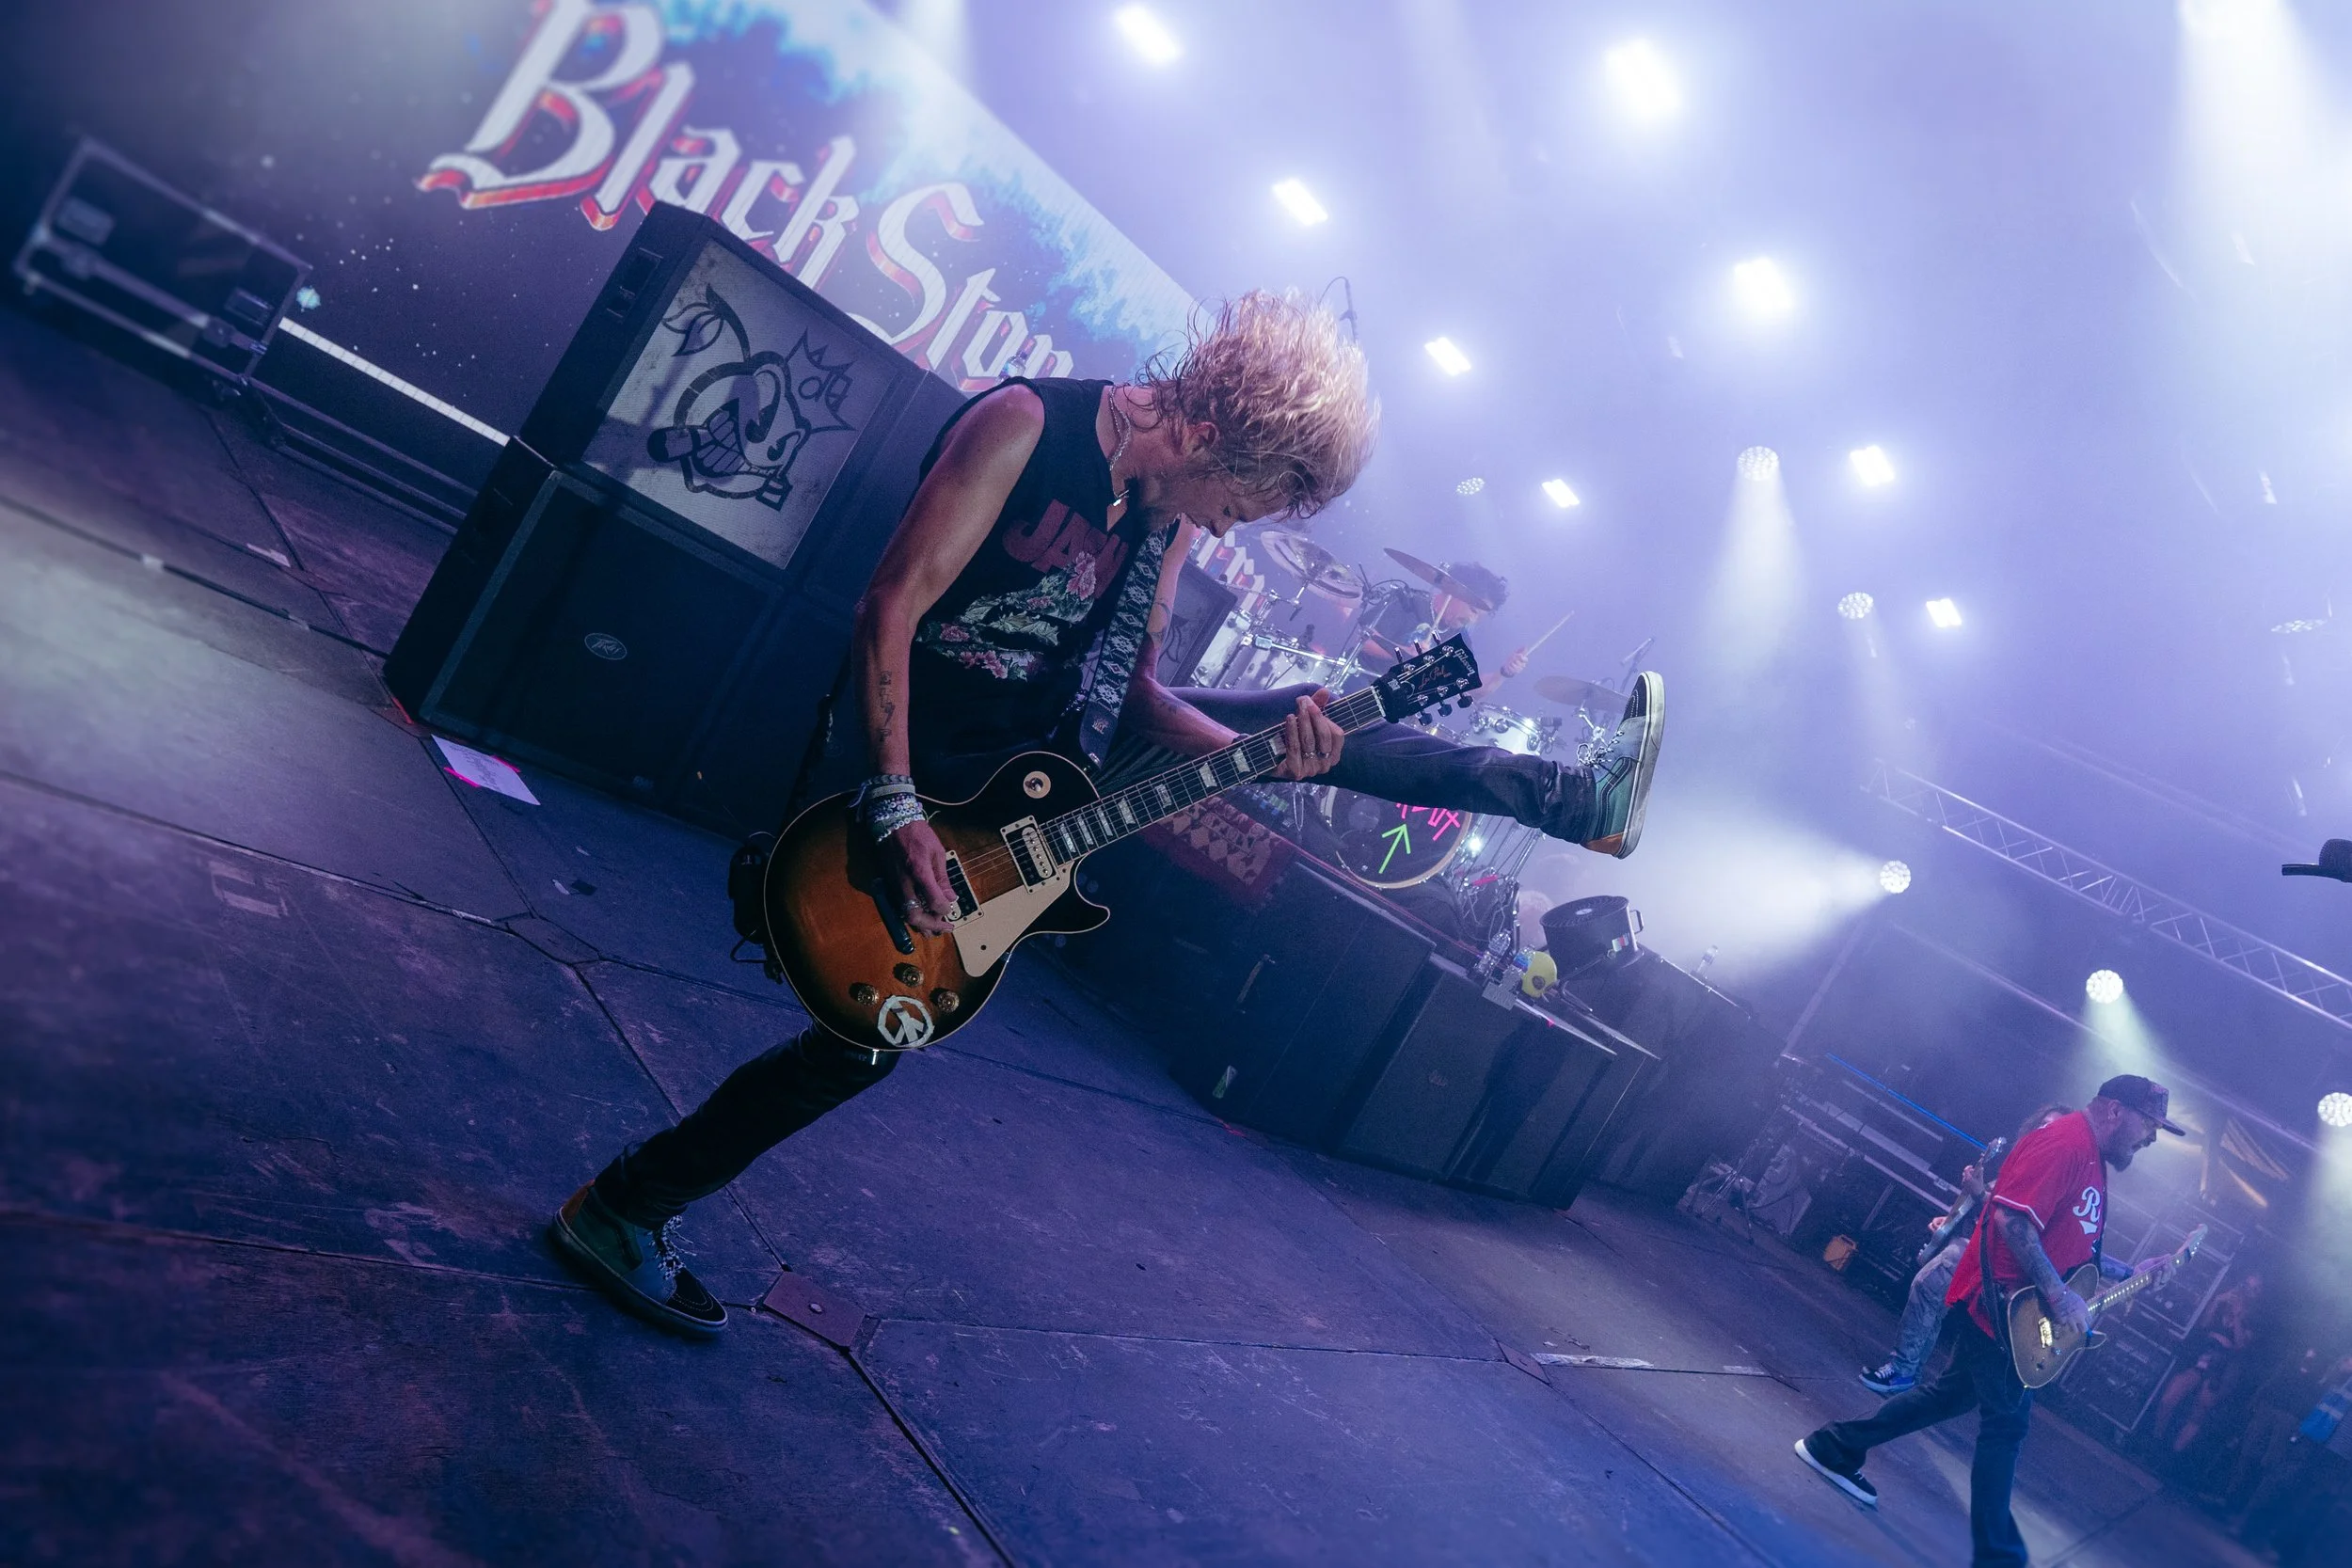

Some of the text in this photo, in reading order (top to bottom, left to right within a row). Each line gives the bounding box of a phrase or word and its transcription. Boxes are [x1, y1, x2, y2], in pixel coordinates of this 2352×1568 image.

[417, 0, 1074, 381] Black Ston
[1452, 648, 1476, 677] Gibson
